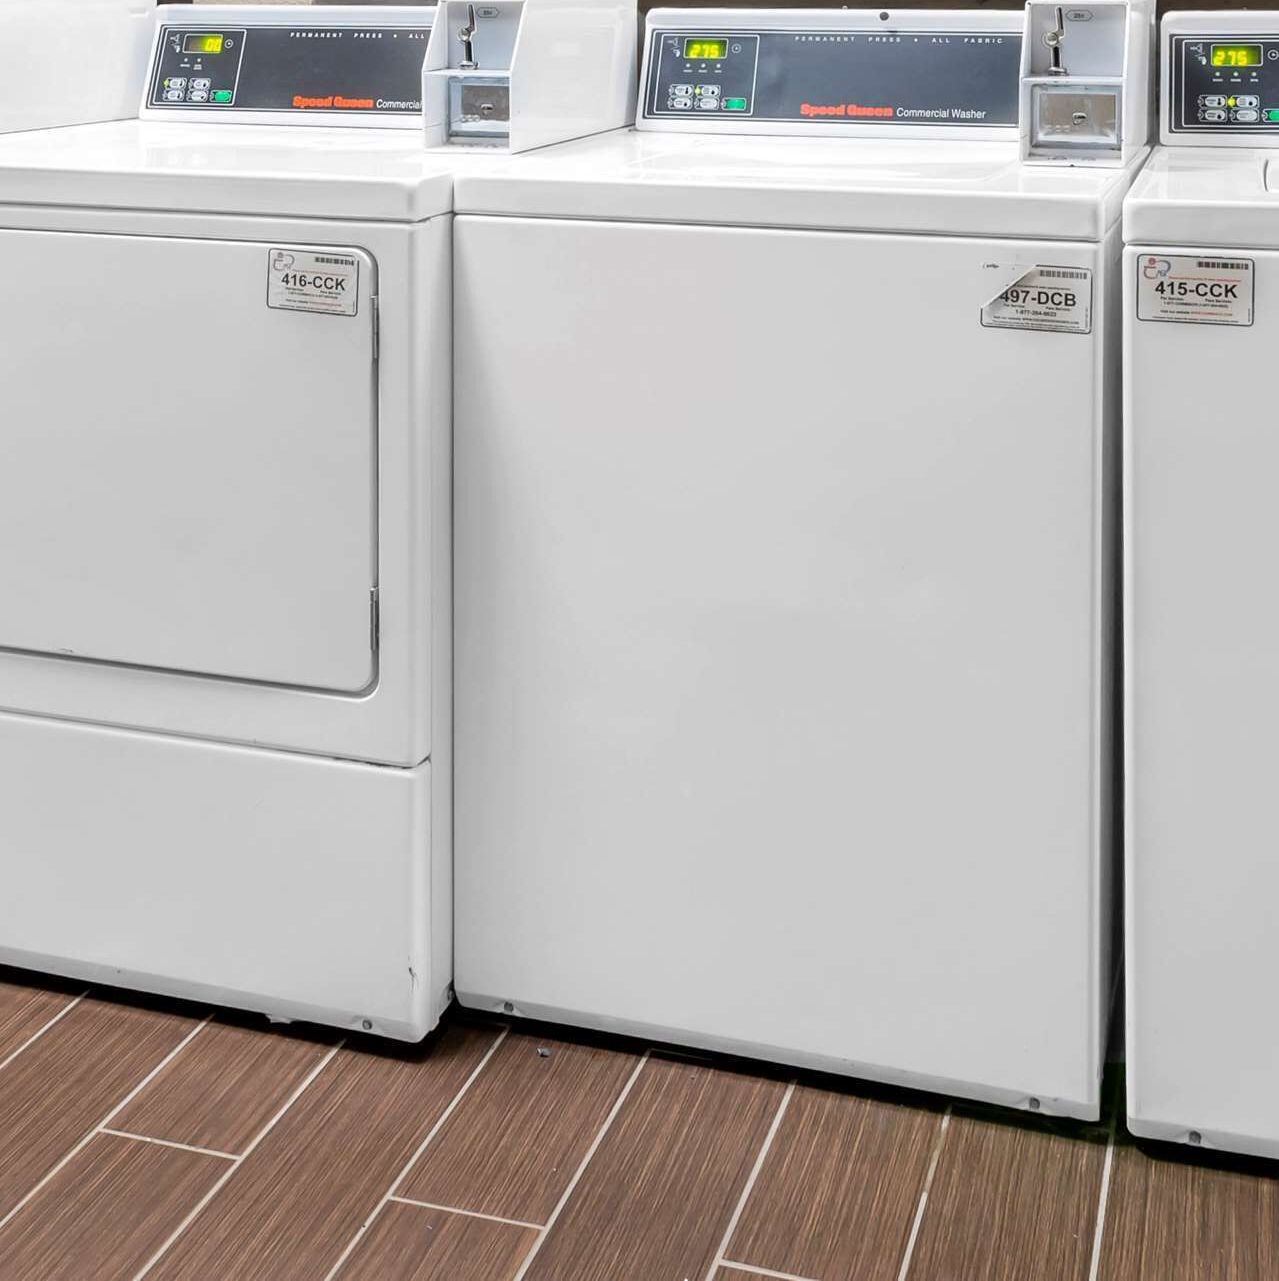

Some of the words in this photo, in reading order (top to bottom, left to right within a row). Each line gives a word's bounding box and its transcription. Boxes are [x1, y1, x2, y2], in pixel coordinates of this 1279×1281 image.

[292, 95, 333, 109] Speed
[334, 96, 374, 108] Queen
[800, 103, 846, 118] Speed
[847, 104, 893, 118] Queen
[896, 107, 950, 118] Commercial
[951, 109, 987, 119] Washer
[281, 273, 345, 291] 416-CCK
[1155, 281, 1238, 298] 415-CCK
